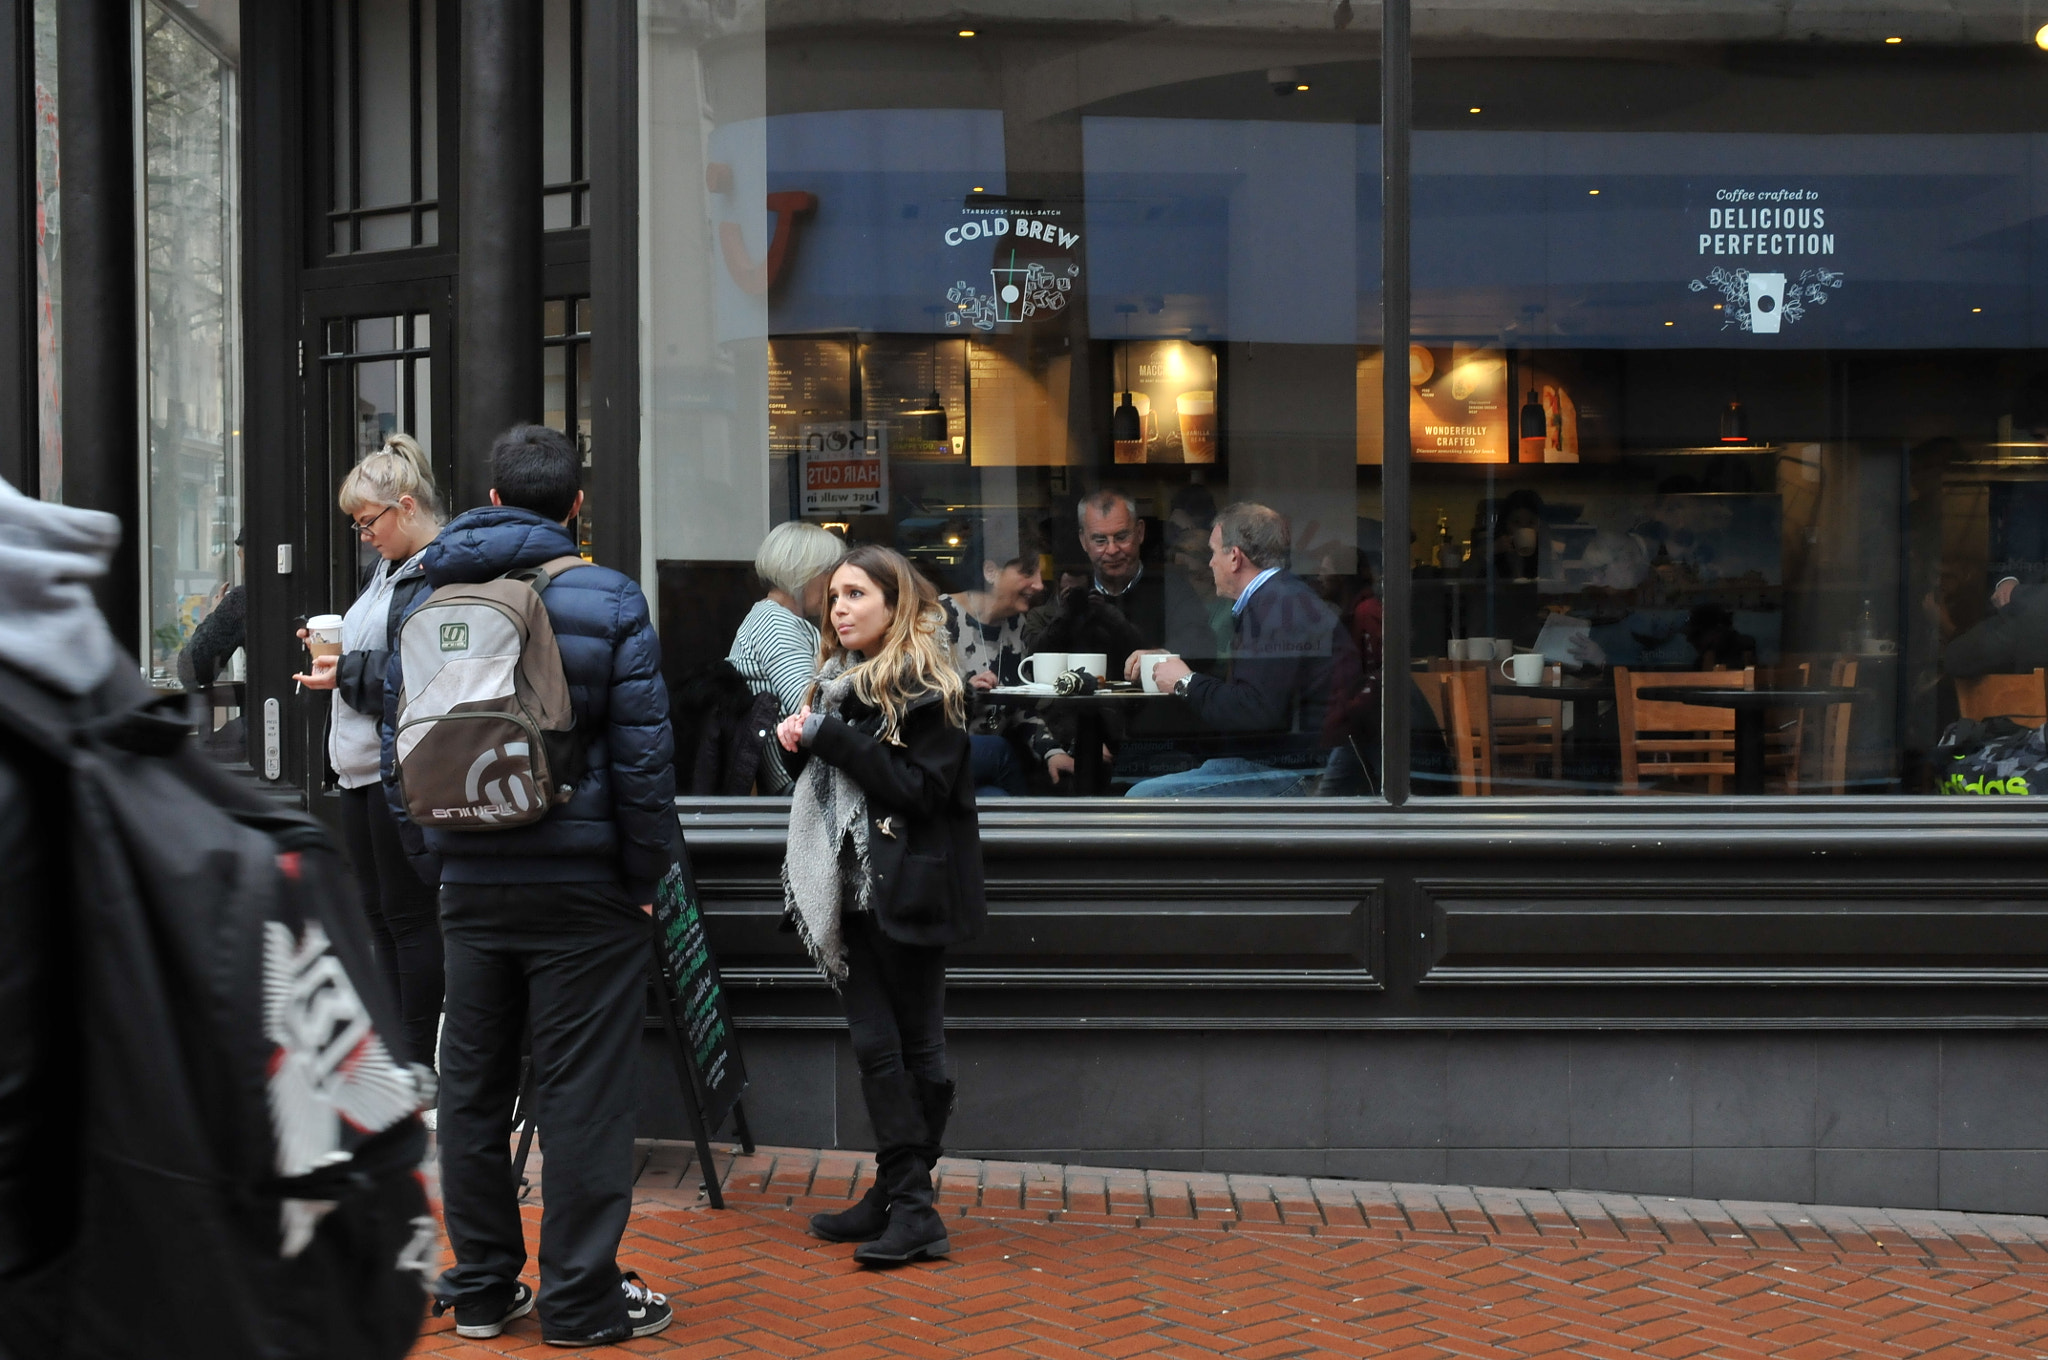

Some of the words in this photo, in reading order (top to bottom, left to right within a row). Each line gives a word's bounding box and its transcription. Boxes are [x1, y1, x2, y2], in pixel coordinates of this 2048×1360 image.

[1716, 189, 1755, 202] Coffee
[1758, 189, 1803, 202] crafted
[1806, 190, 1819, 200] to
[1709, 208, 1825, 229] DELICIOUS
[944, 218, 1010, 247] COLD
[1015, 218, 1080, 250] BREW
[1699, 234, 1835, 255] PERFECTION
[1424, 426, 1487, 436] WONDERFULLY
[1436, 437, 1475, 447] CRAFTED
